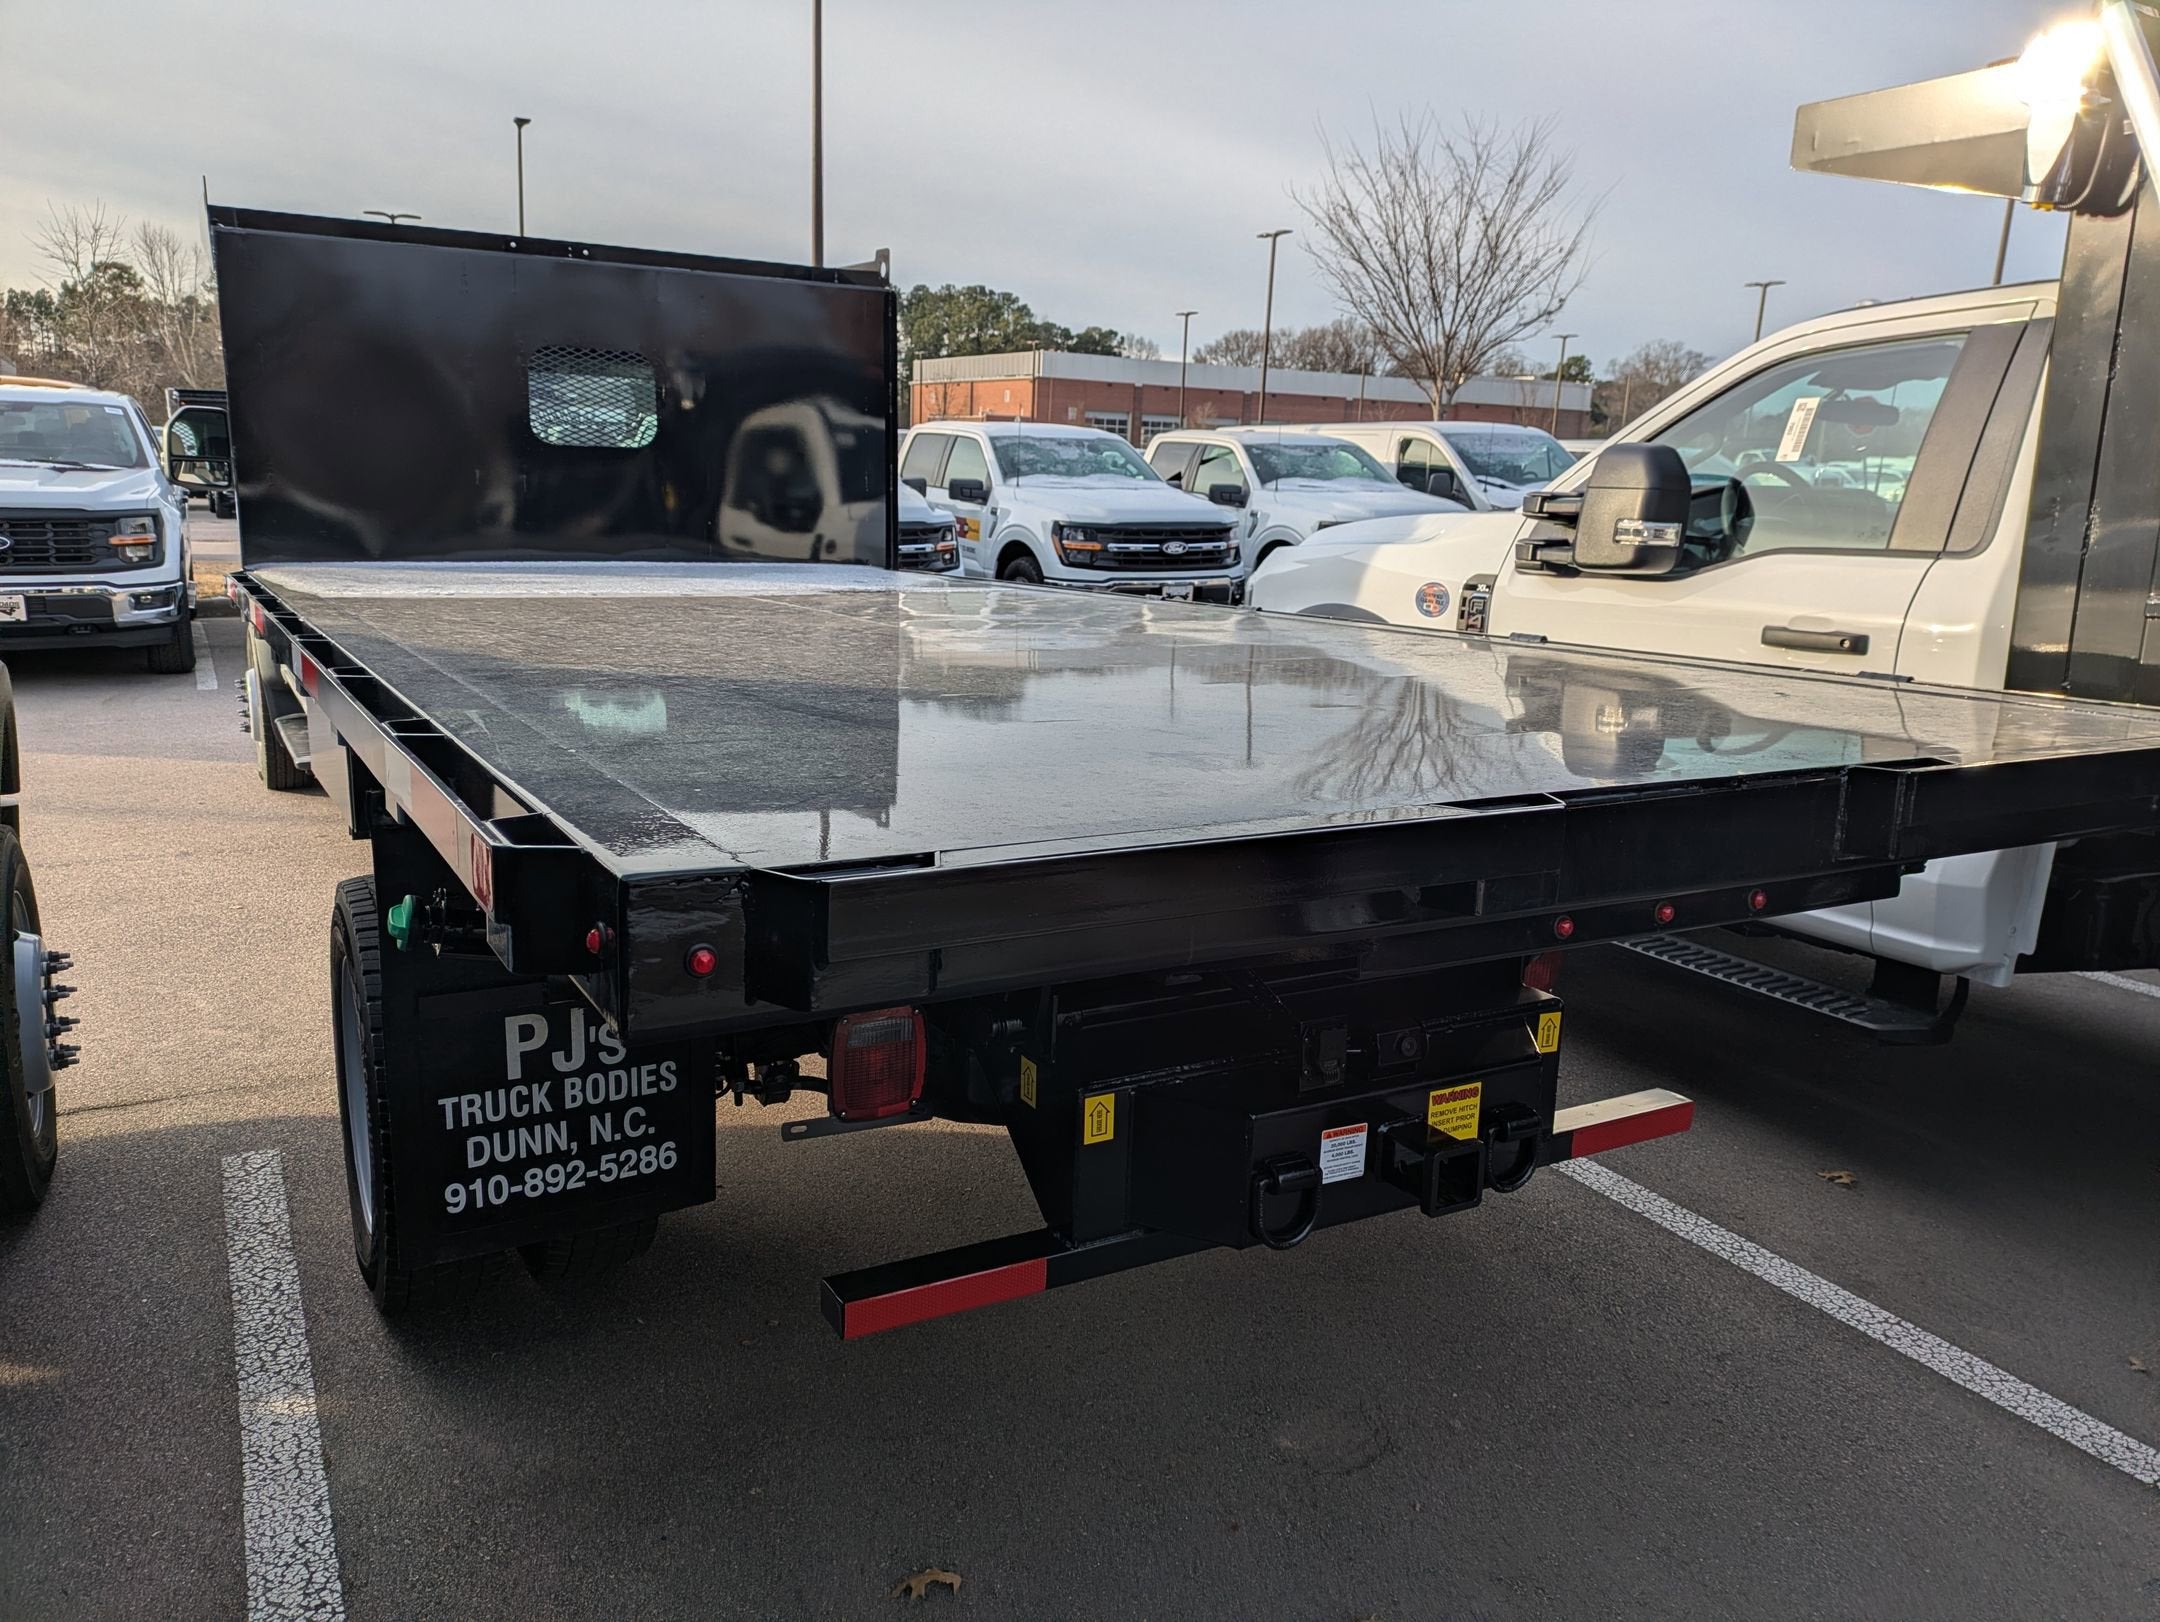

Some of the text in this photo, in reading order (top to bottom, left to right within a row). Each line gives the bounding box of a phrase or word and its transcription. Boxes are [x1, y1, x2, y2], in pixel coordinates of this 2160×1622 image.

[438, 1060, 677, 1130] TRUCK BODIES
[1432, 1086, 1480, 1106] WARNING
[1430, 1103, 1478, 1119] REMOVE HITCH
[1431, 1112, 1476, 1127] INSERT PRIOR
[1333, 1124, 1366, 1138] WARNING
[1443, 1122, 1473, 1133] DUMPING
[466, 1106, 655, 1169] DUNN, N.C.
[444, 1141, 678, 1214] 910-892-5286
